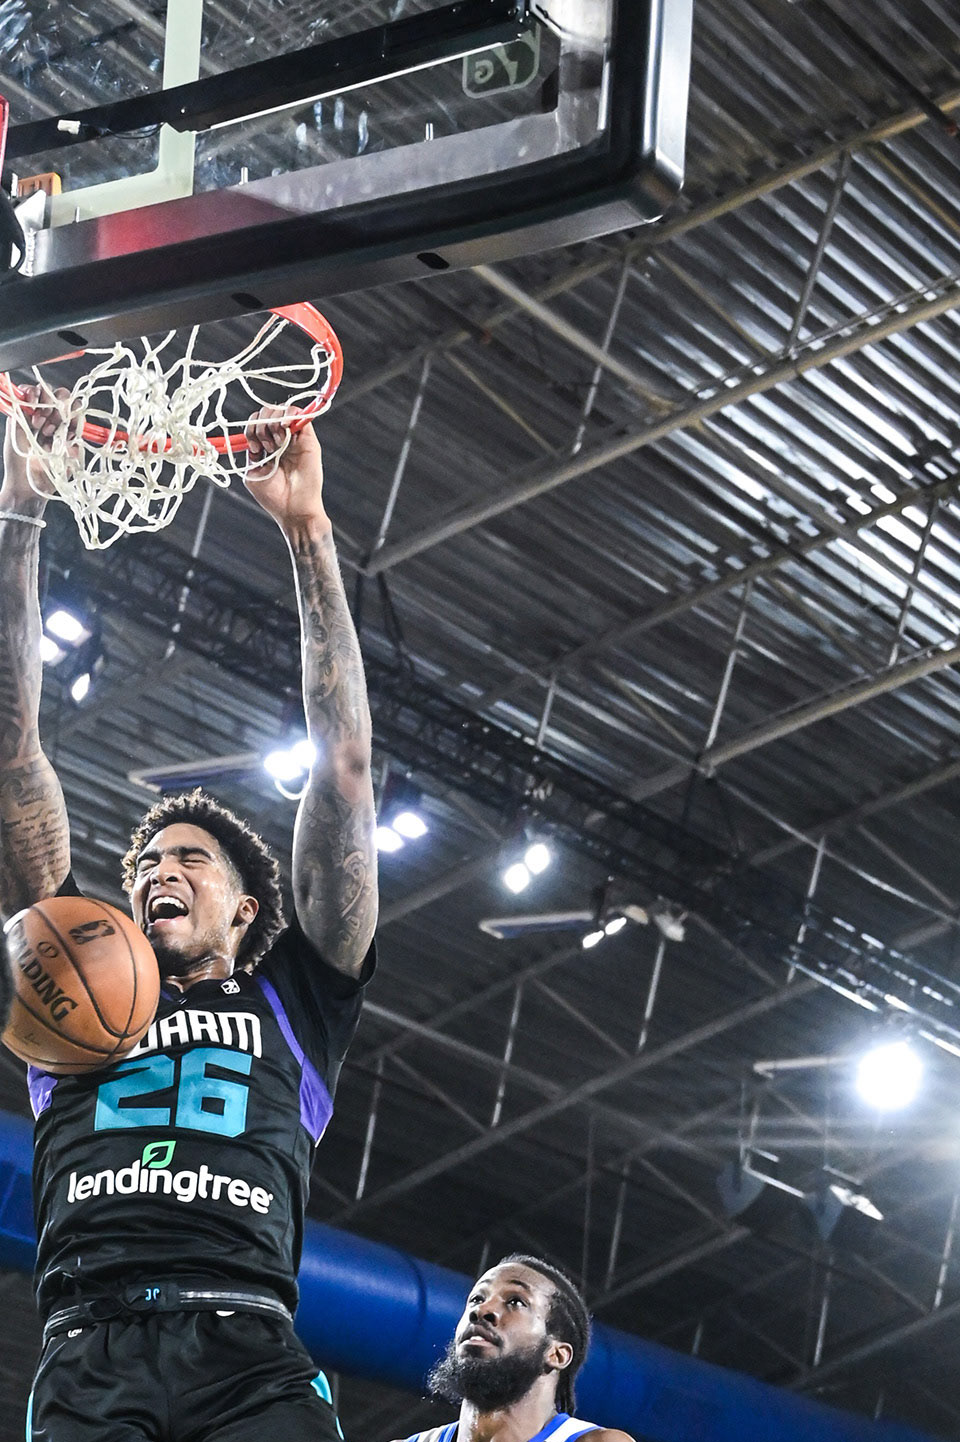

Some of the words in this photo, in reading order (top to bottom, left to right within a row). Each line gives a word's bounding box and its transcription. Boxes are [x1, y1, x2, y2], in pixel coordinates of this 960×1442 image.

[125, 1009, 263, 1059] ARM
[94, 1047, 252, 1138] 26
[67, 1159, 272, 1214] lendingtree
